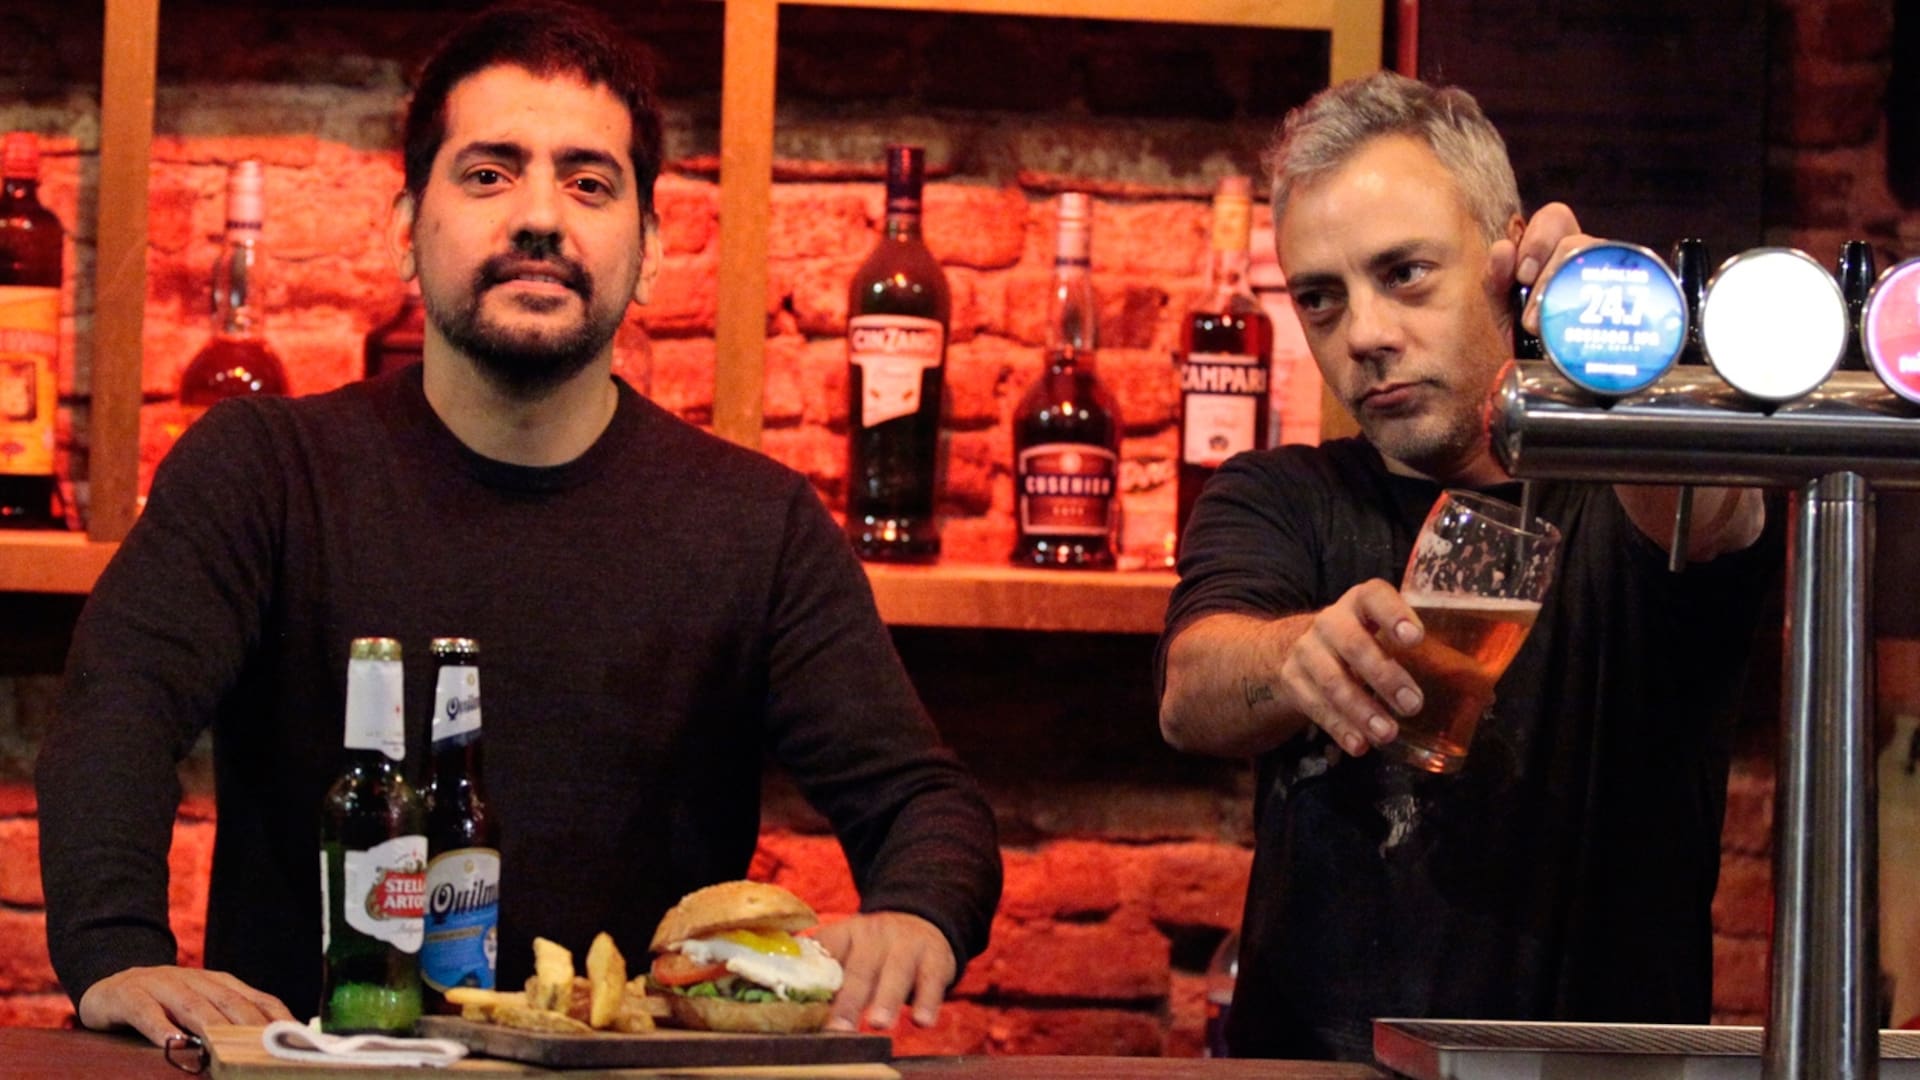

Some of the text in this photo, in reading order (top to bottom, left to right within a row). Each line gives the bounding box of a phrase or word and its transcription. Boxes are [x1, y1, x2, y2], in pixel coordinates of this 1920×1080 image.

[1180, 363, 1267, 393] CAMPARI
[384, 877, 425, 894] STELL
[382, 894, 425, 910] ARTO
[428, 877, 499, 925] Quilm
